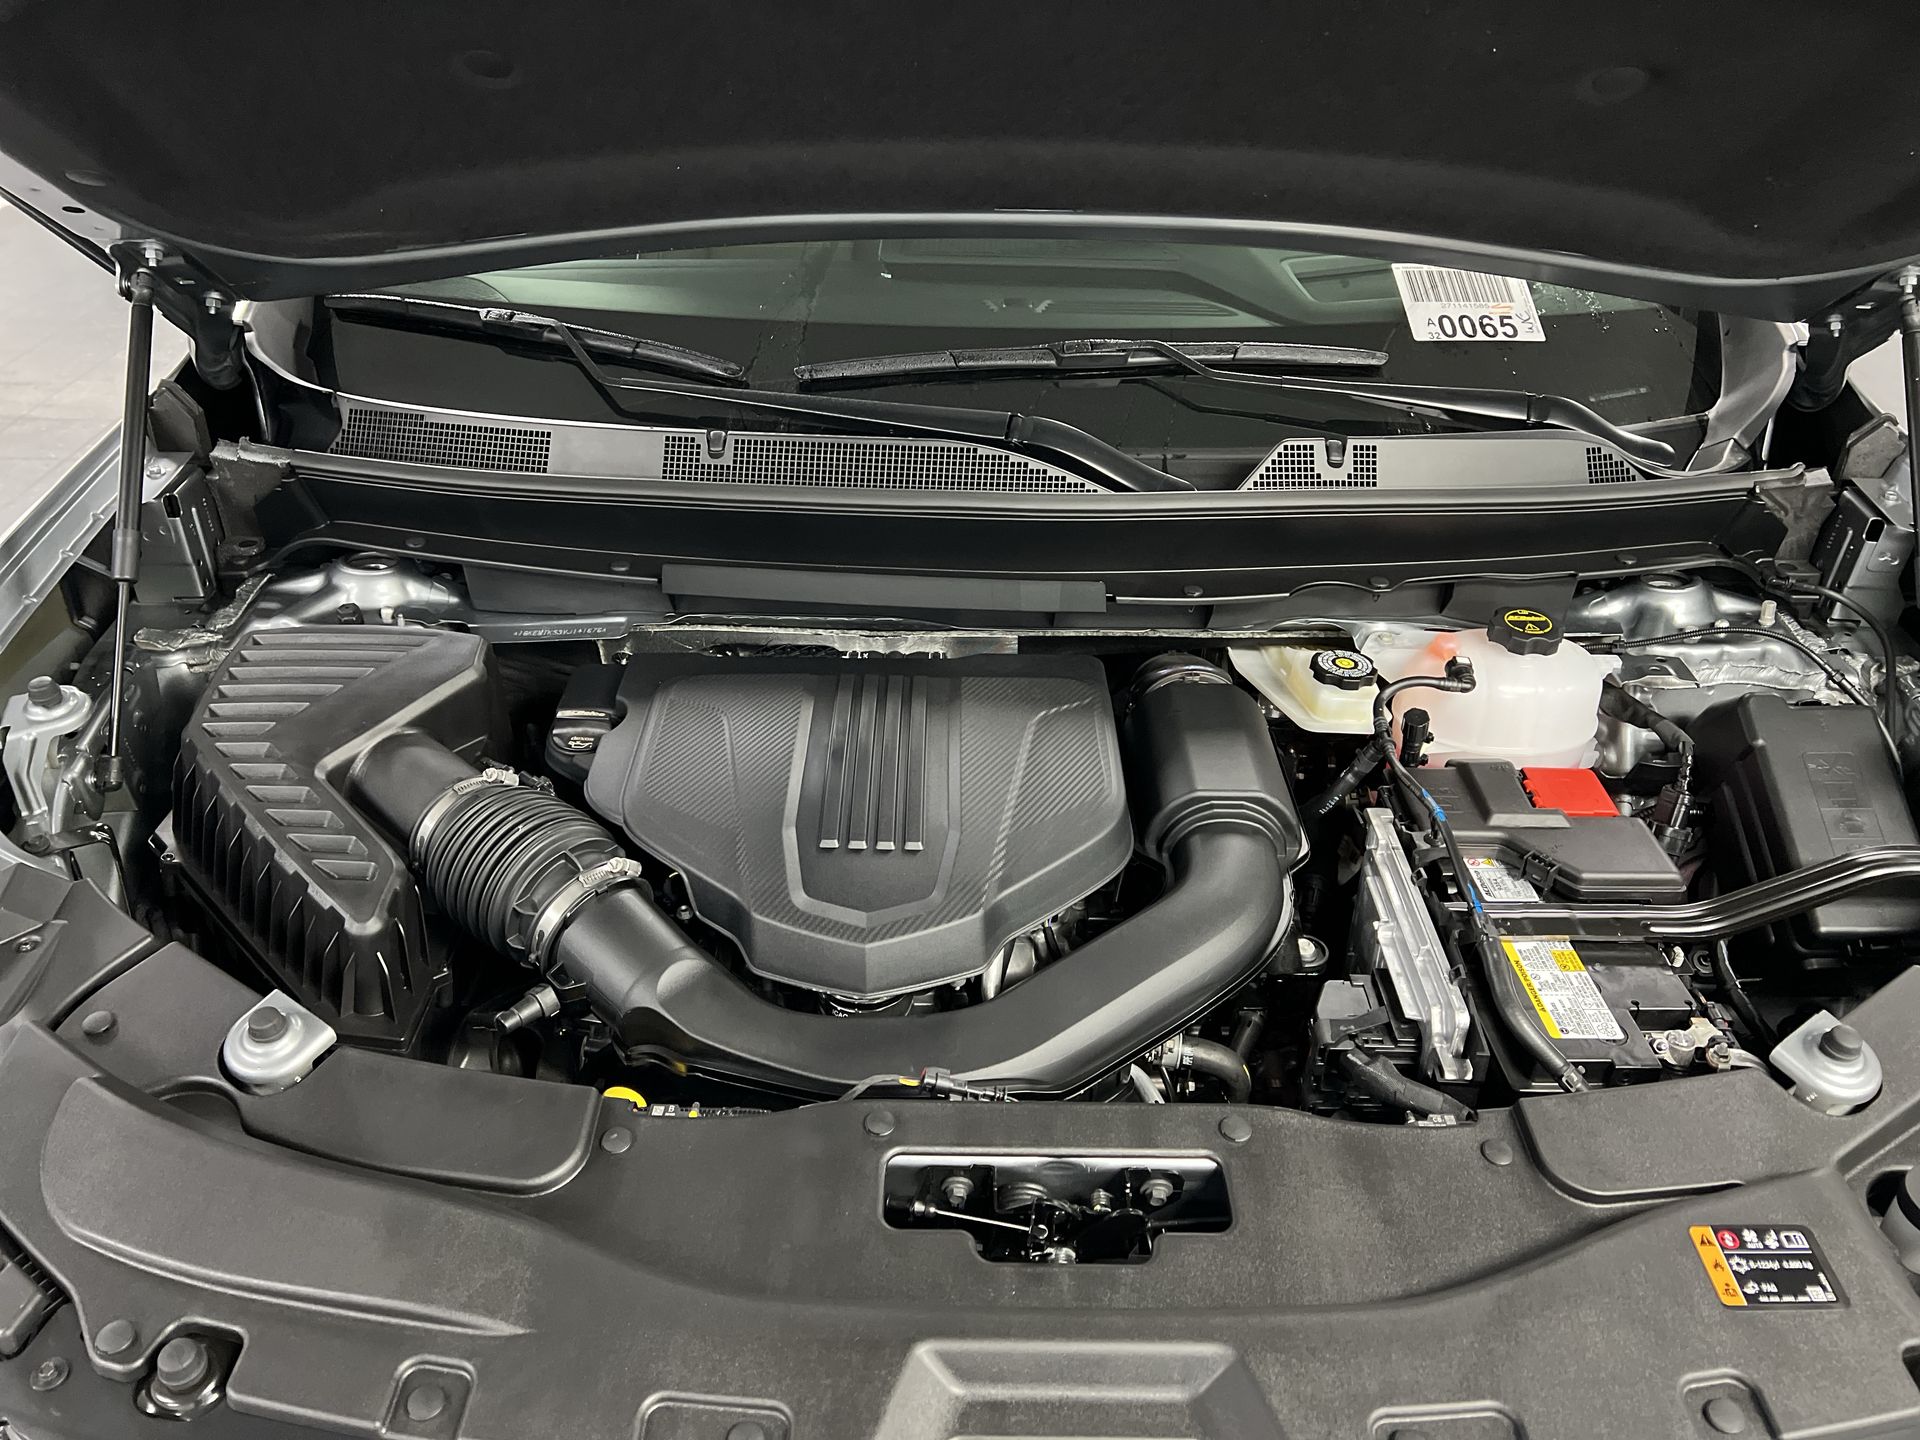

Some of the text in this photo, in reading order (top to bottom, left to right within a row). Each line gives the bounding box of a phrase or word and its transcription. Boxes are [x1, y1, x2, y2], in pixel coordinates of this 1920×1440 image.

[1427, 317, 1437, 327] A
[1437, 314, 1519, 339] 0065
[1428, 331, 1442, 340] 32
[1513, 959, 1544, 1008] DANGER POISON
